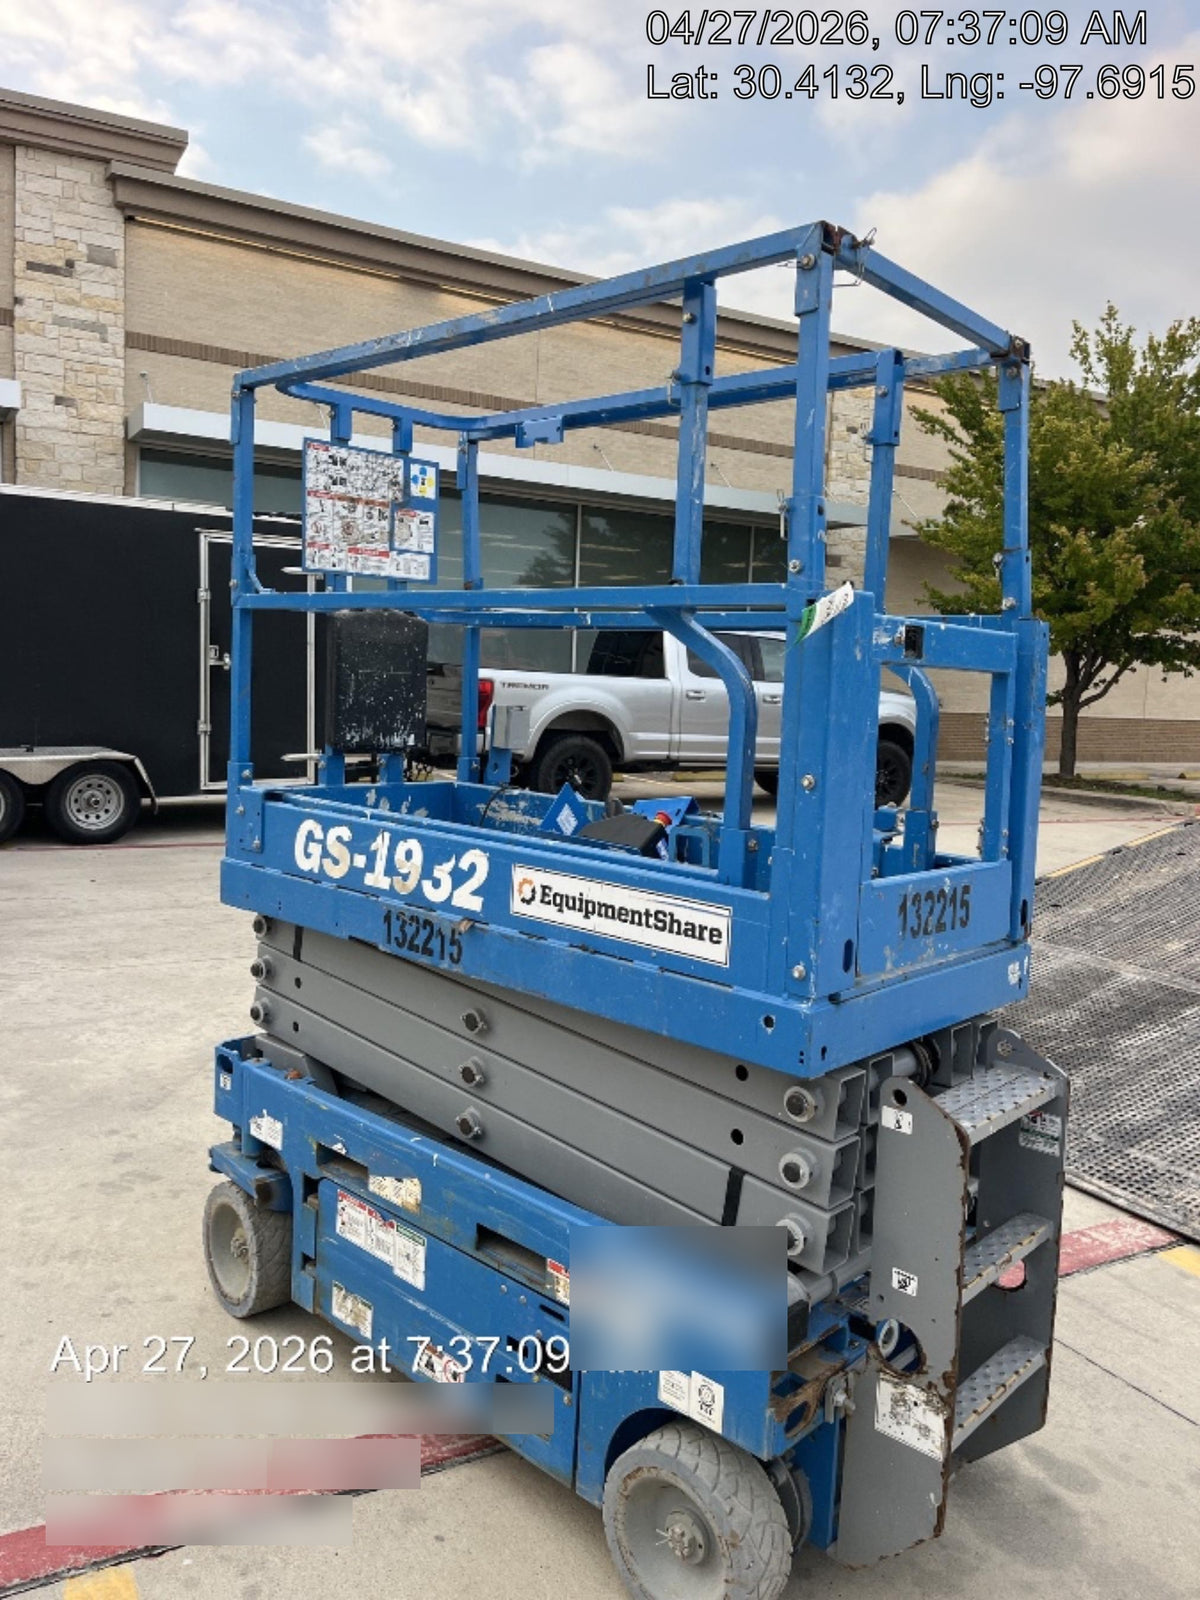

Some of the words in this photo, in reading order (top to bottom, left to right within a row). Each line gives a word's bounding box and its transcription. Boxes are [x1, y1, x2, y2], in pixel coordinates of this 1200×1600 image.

[383, 909, 463, 965] 132215
[540, 884, 724, 946] EquipmentShare
[898, 884, 971, 940] 132215
